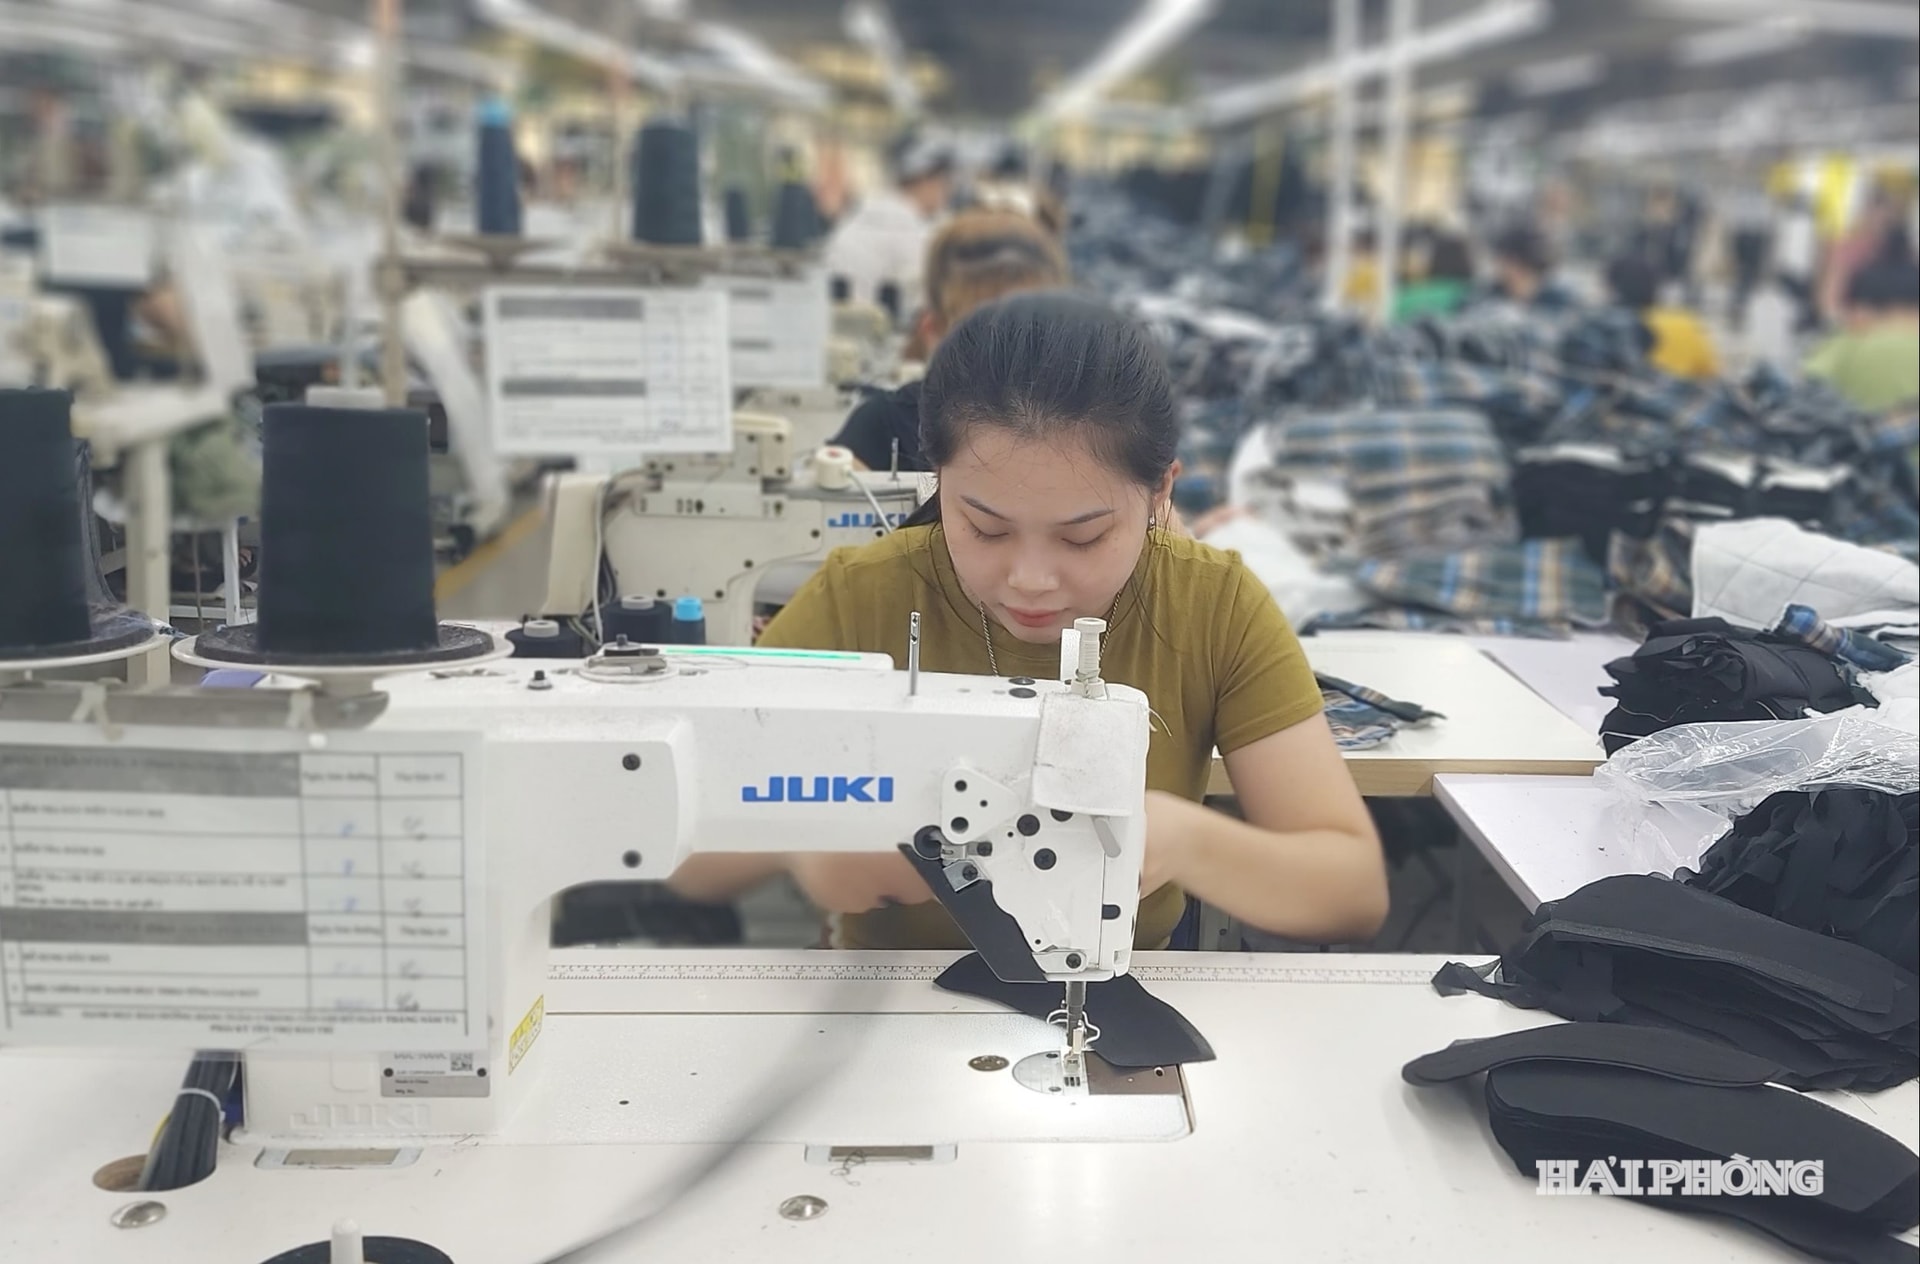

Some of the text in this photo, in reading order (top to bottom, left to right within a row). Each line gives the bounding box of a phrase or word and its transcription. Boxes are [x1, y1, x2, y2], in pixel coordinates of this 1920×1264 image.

[828, 513, 907, 528] JUKI
[742, 776, 894, 802] JUKI
[290, 1103, 430, 1129] JUKI
